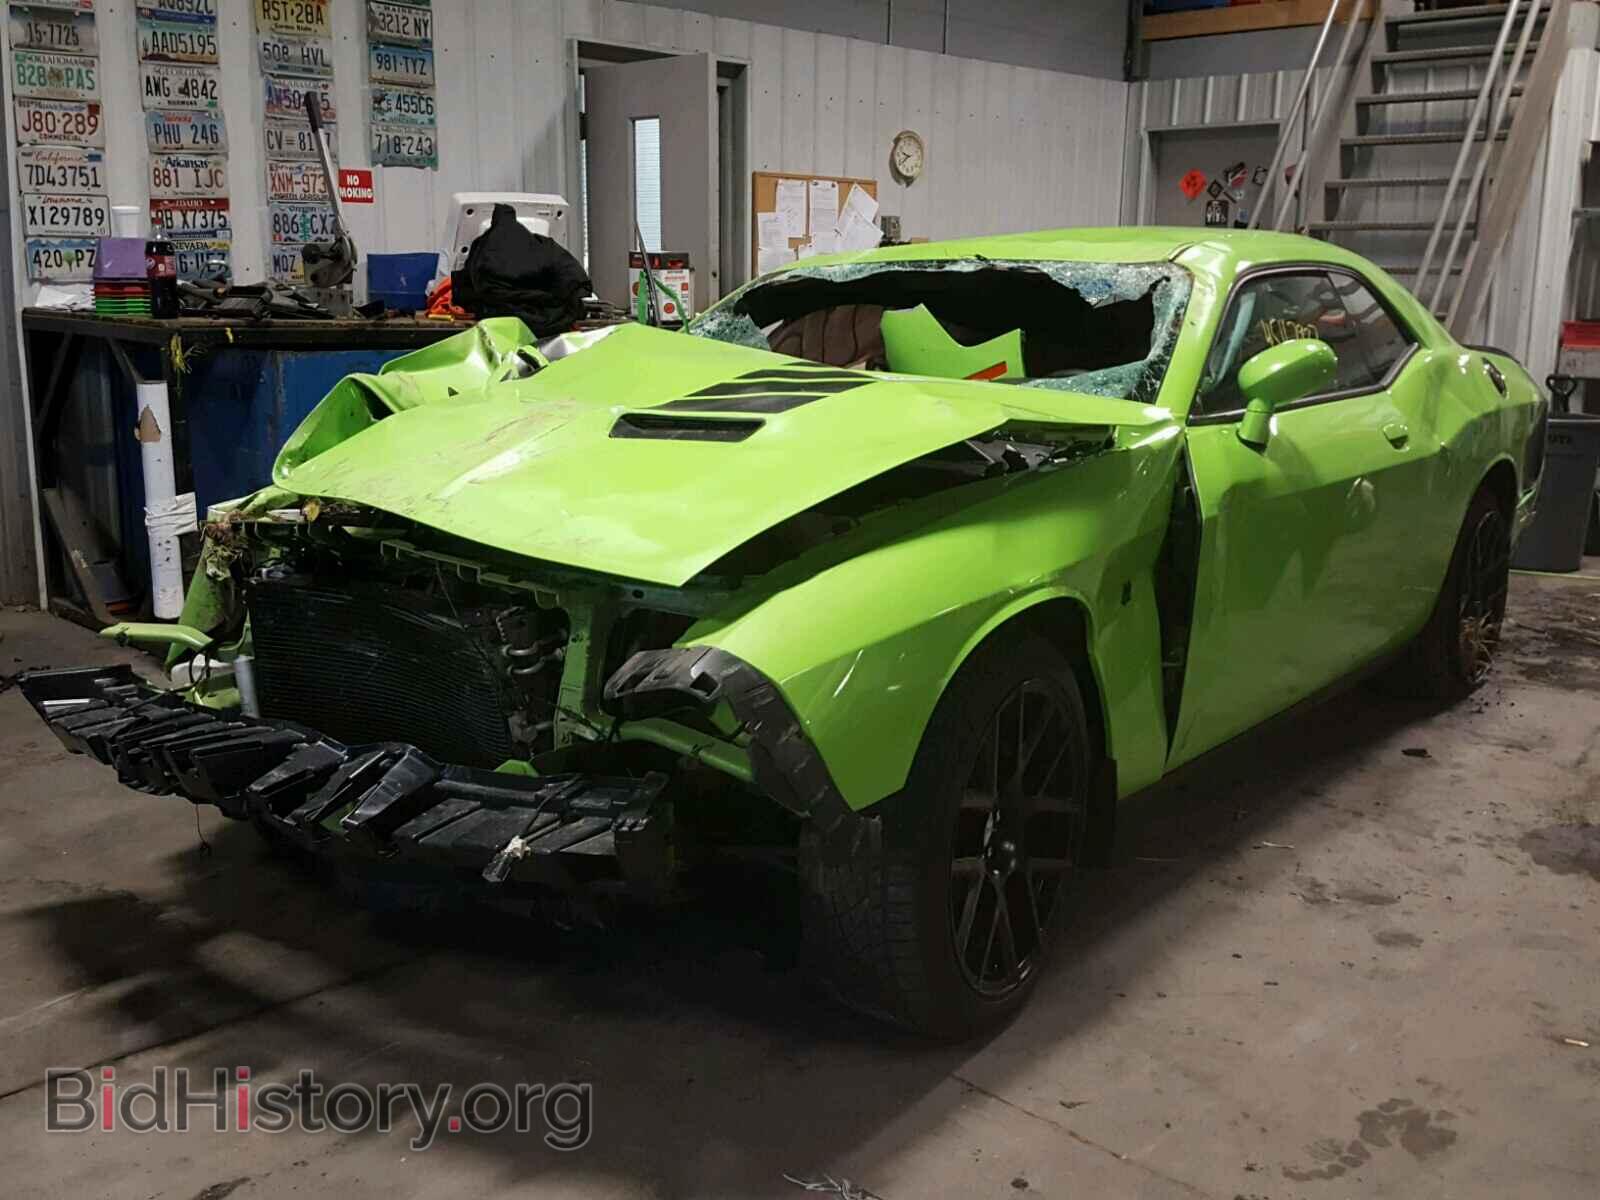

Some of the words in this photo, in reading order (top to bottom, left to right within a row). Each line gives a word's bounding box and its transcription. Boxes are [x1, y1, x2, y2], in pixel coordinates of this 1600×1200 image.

[379, 13, 409, 35] 3212
[414, 18, 430, 37] NY
[151, 31, 217, 56] AAD5195
[263, 42, 289, 63] 508
[301, 45, 331, 67] HVL
[17, 64, 47, 87] 828
[64, 68, 95, 91] PAS
[181, 78, 218, 100] 4842
[154, 124, 181, 145] PHU
[165, 156, 209, 169] Arkansas
[25, 164, 102, 188] 7D43751
[153, 168, 180, 188] 881
[347, 175, 359, 185] NO
[340, 187, 373, 198] MOKING
[28, 206, 104, 227] X129789
[182, 209, 227, 230] X7375
[273, 213, 299, 235] 886
[174, 241, 209, 250] NEVADA
[33, 249, 63, 269] 420
[75, 249, 95, 268] PZ
